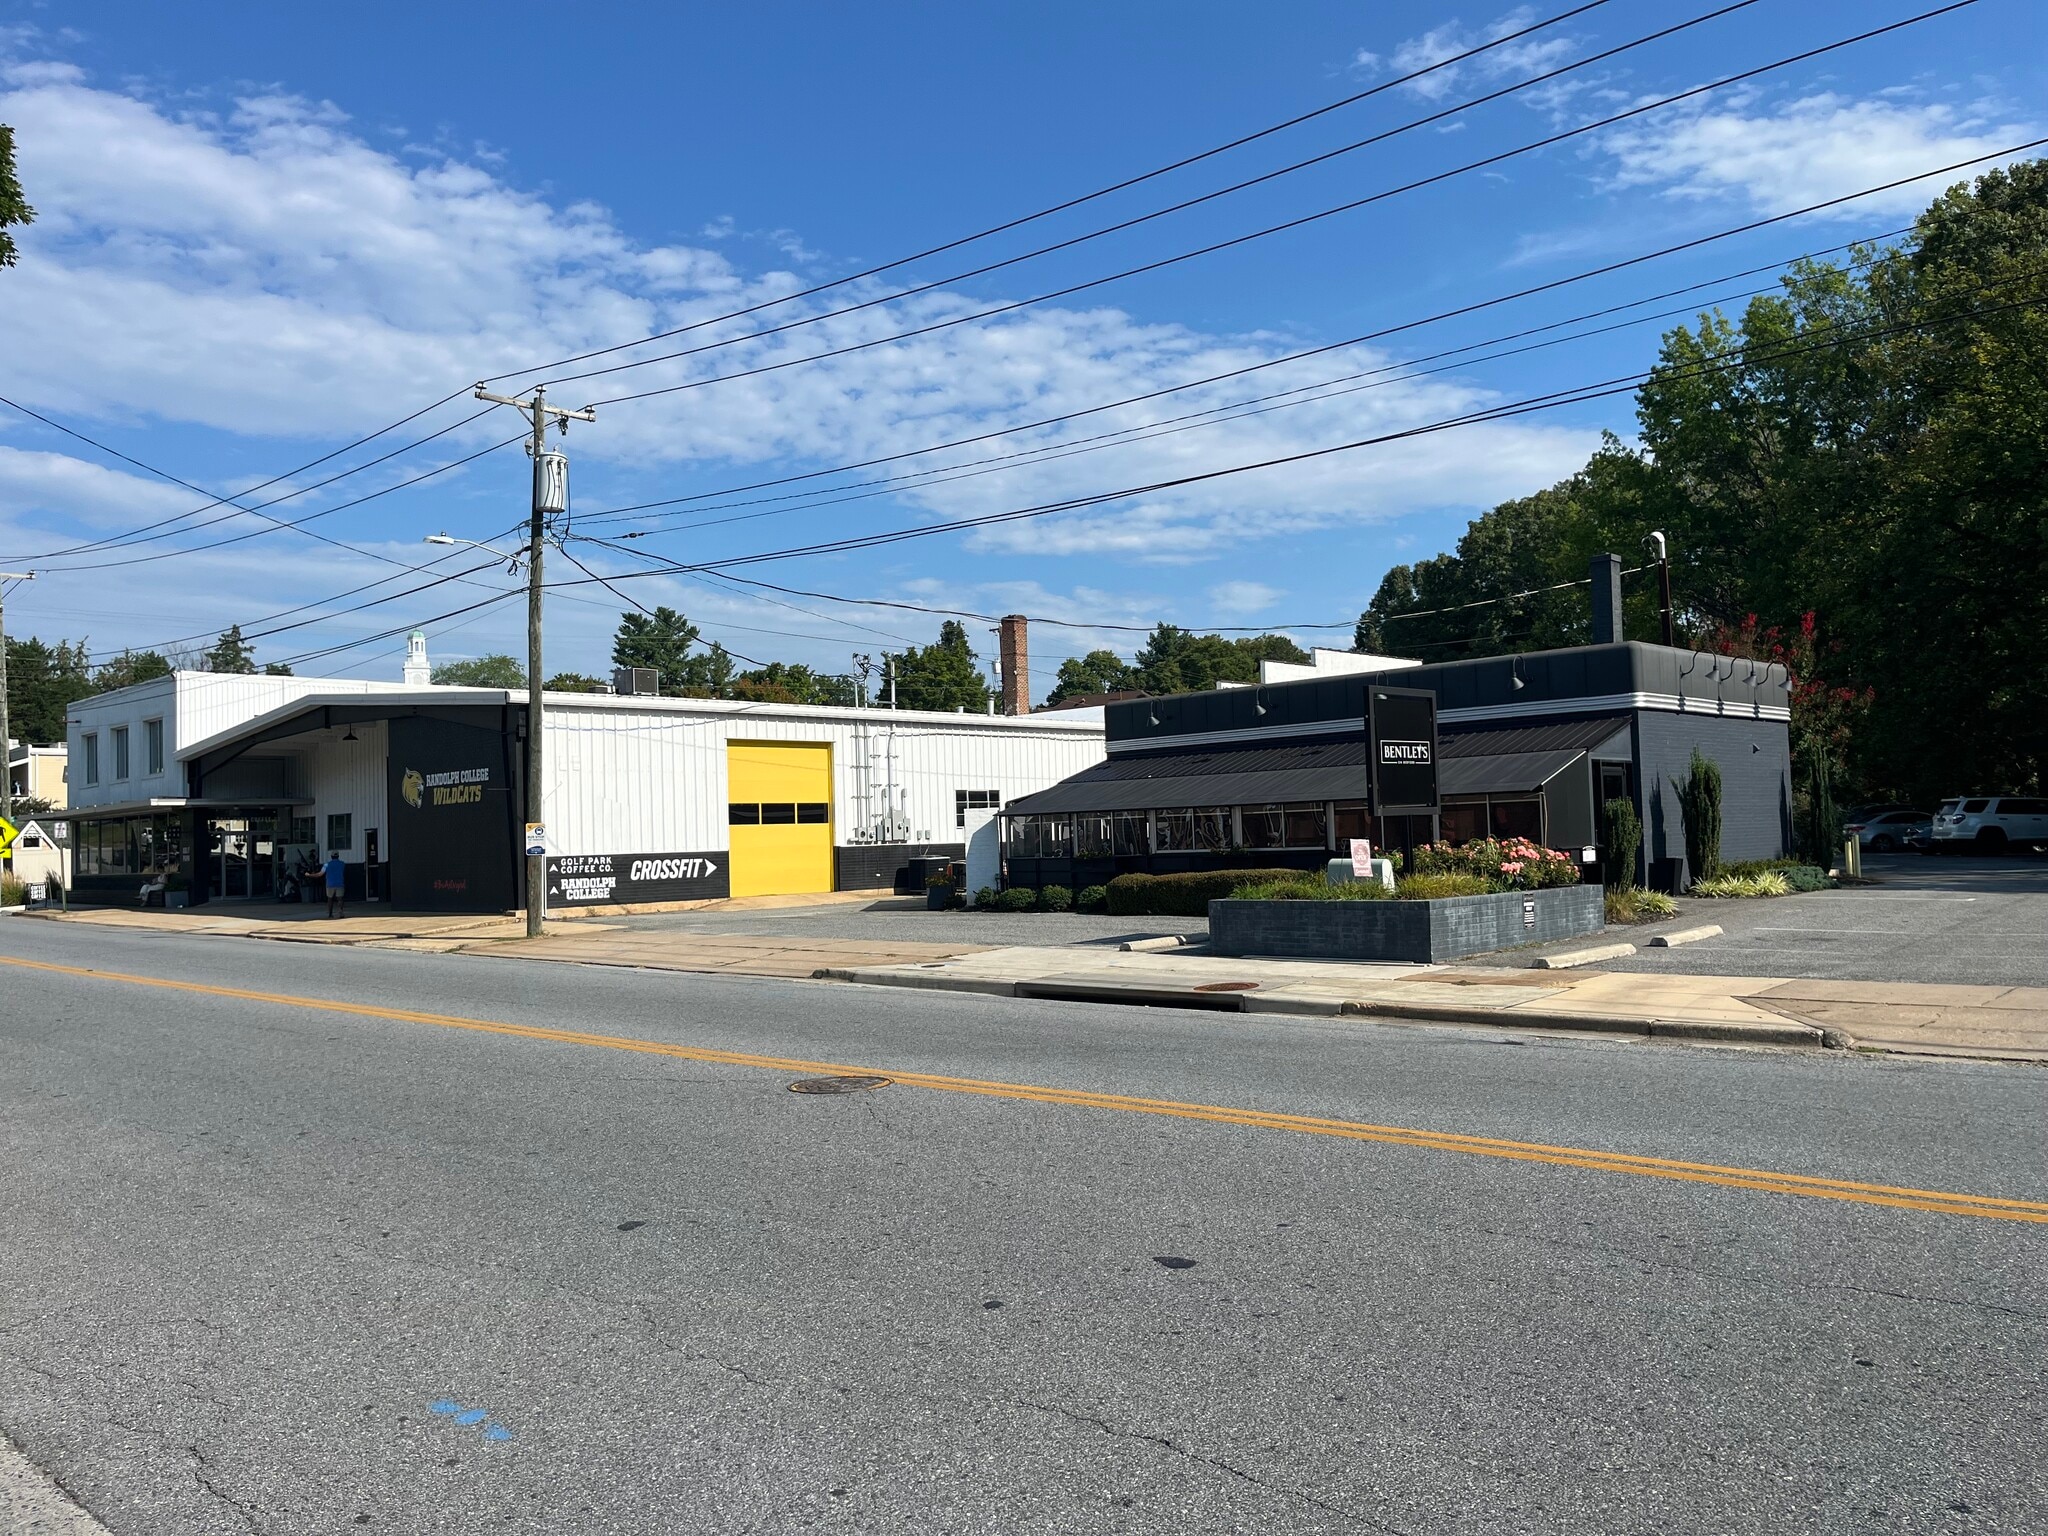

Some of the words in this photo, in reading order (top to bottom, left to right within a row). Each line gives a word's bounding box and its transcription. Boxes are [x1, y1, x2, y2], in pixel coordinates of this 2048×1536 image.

[426, 771, 460, 787] RANDOLPH
[460, 768, 489, 783] COLLEGE
[433, 784, 482, 805] WILDCATS
[560, 857, 584, 866] GOLF
[588, 856, 612, 865] PARK
[560, 865, 596, 874] COFFEE
[599, 864, 614, 873] CO.
[630, 858, 703, 881] CROSSFIT
[560, 876, 616, 890] RANDOLPH
[566, 888, 610, 900] COLLEGE
